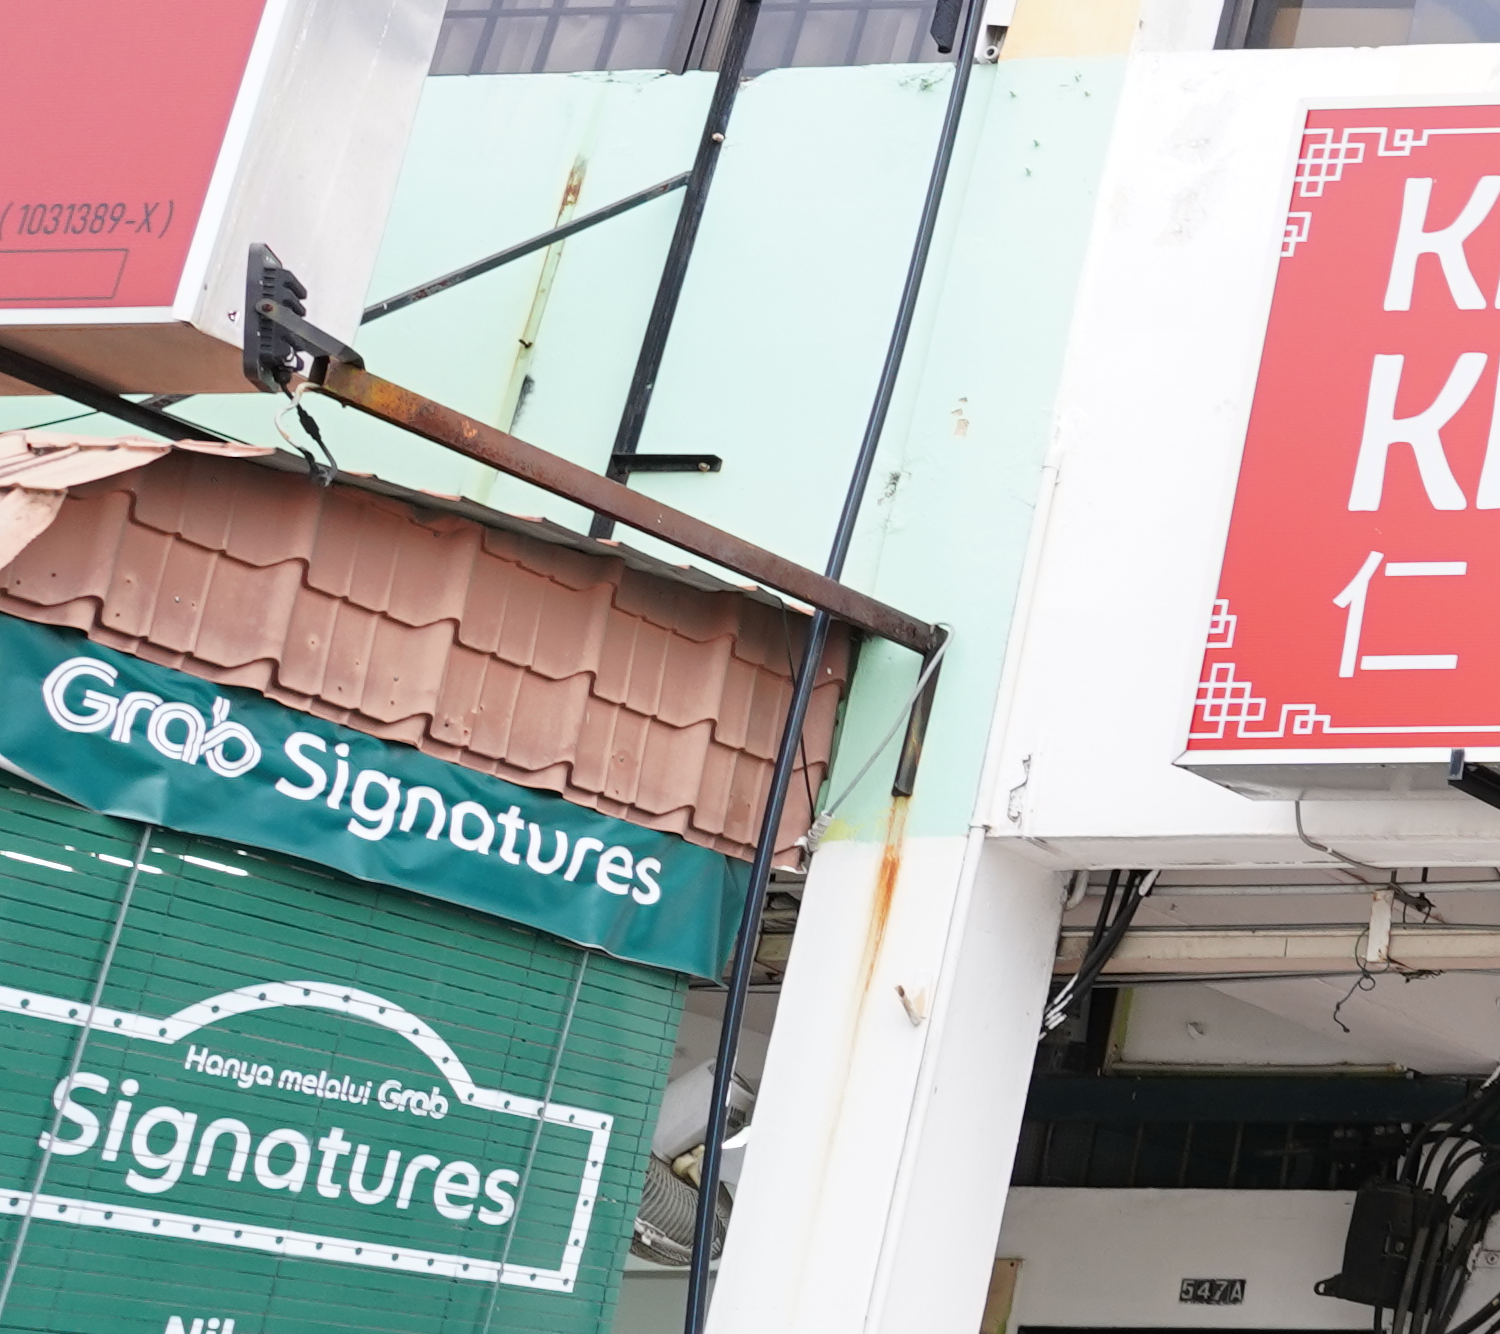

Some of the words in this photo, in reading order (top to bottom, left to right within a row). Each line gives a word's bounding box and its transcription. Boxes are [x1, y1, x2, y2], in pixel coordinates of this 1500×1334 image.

[43, 655, 262, 779] Grab
[275, 732, 663, 906] Signatures
[185, 1045, 275, 1089] Hanya
[278, 1070, 373, 1106] melalui
[377, 1079, 449, 1120] Grab
[38, 1071, 521, 1227] Signatures
[1180, 1279, 1243, 1302] 547A
